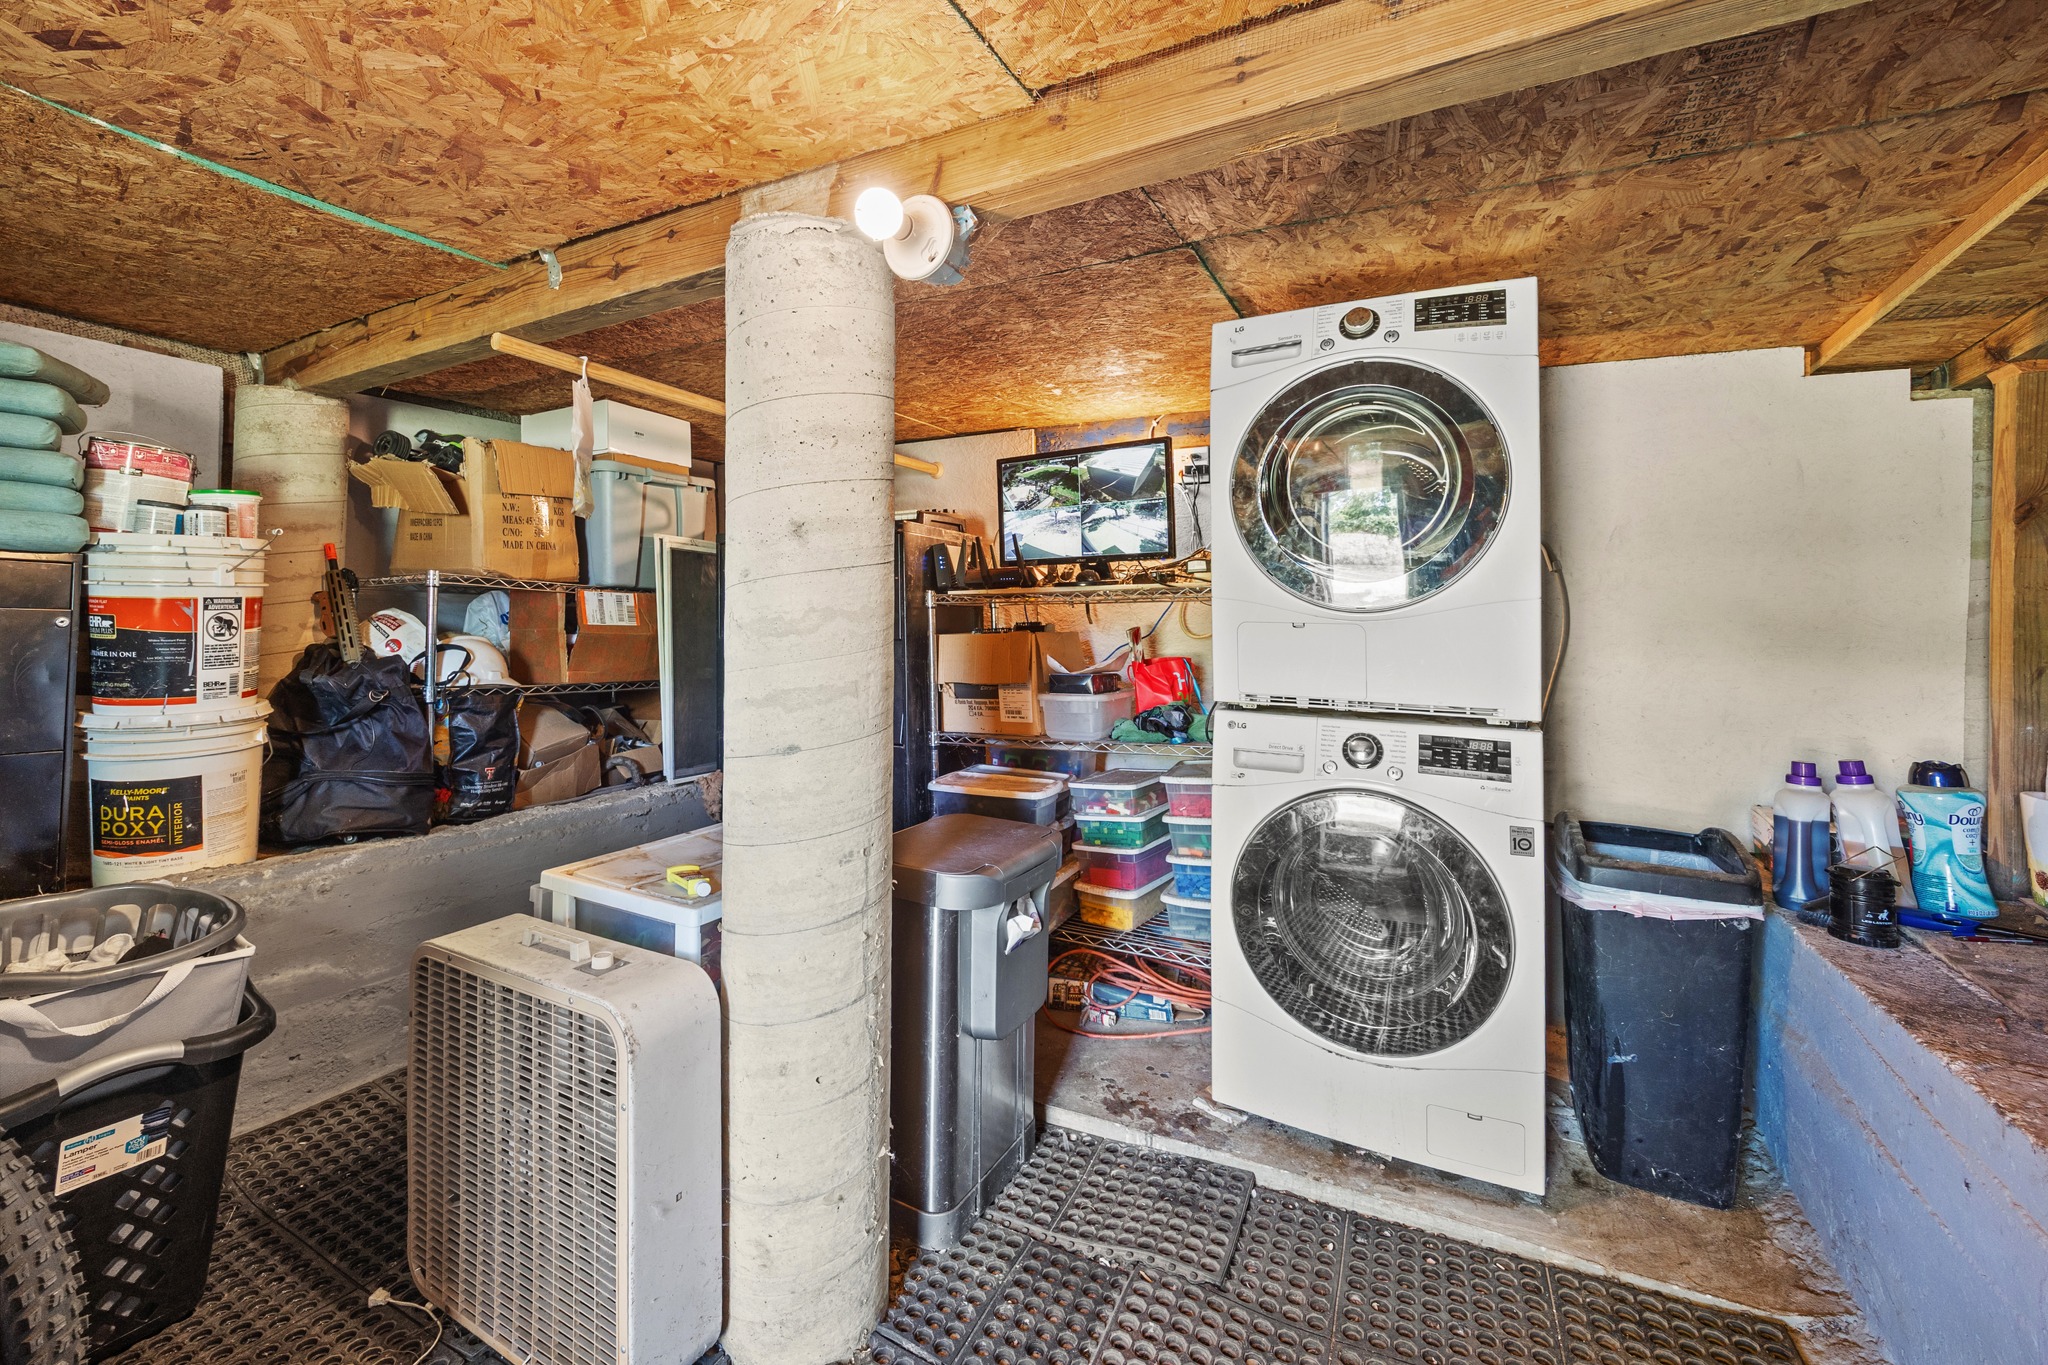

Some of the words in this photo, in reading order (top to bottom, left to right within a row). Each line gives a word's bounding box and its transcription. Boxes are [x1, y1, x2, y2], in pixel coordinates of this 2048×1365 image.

[502, 503, 520, 512] N.W.:
[553, 507, 565, 516] KGS
[502, 516, 524, 525] MEAS:
[556, 519, 565, 528] CM
[502, 528, 522, 538] C/NO:
[502, 540, 524, 550] MADE
[526, 541, 534, 550] IN
[536, 541, 556, 551] CHINA
[110, 787, 168, 795] KELLY-MOORE
[101, 805, 165, 821] DURA
[101, 820, 166, 837] POXY
[174, 802, 183, 845] INTERIOR
[1512, 838, 1532, 851] 10
[64, 1144, 98, 1159] Lamper
